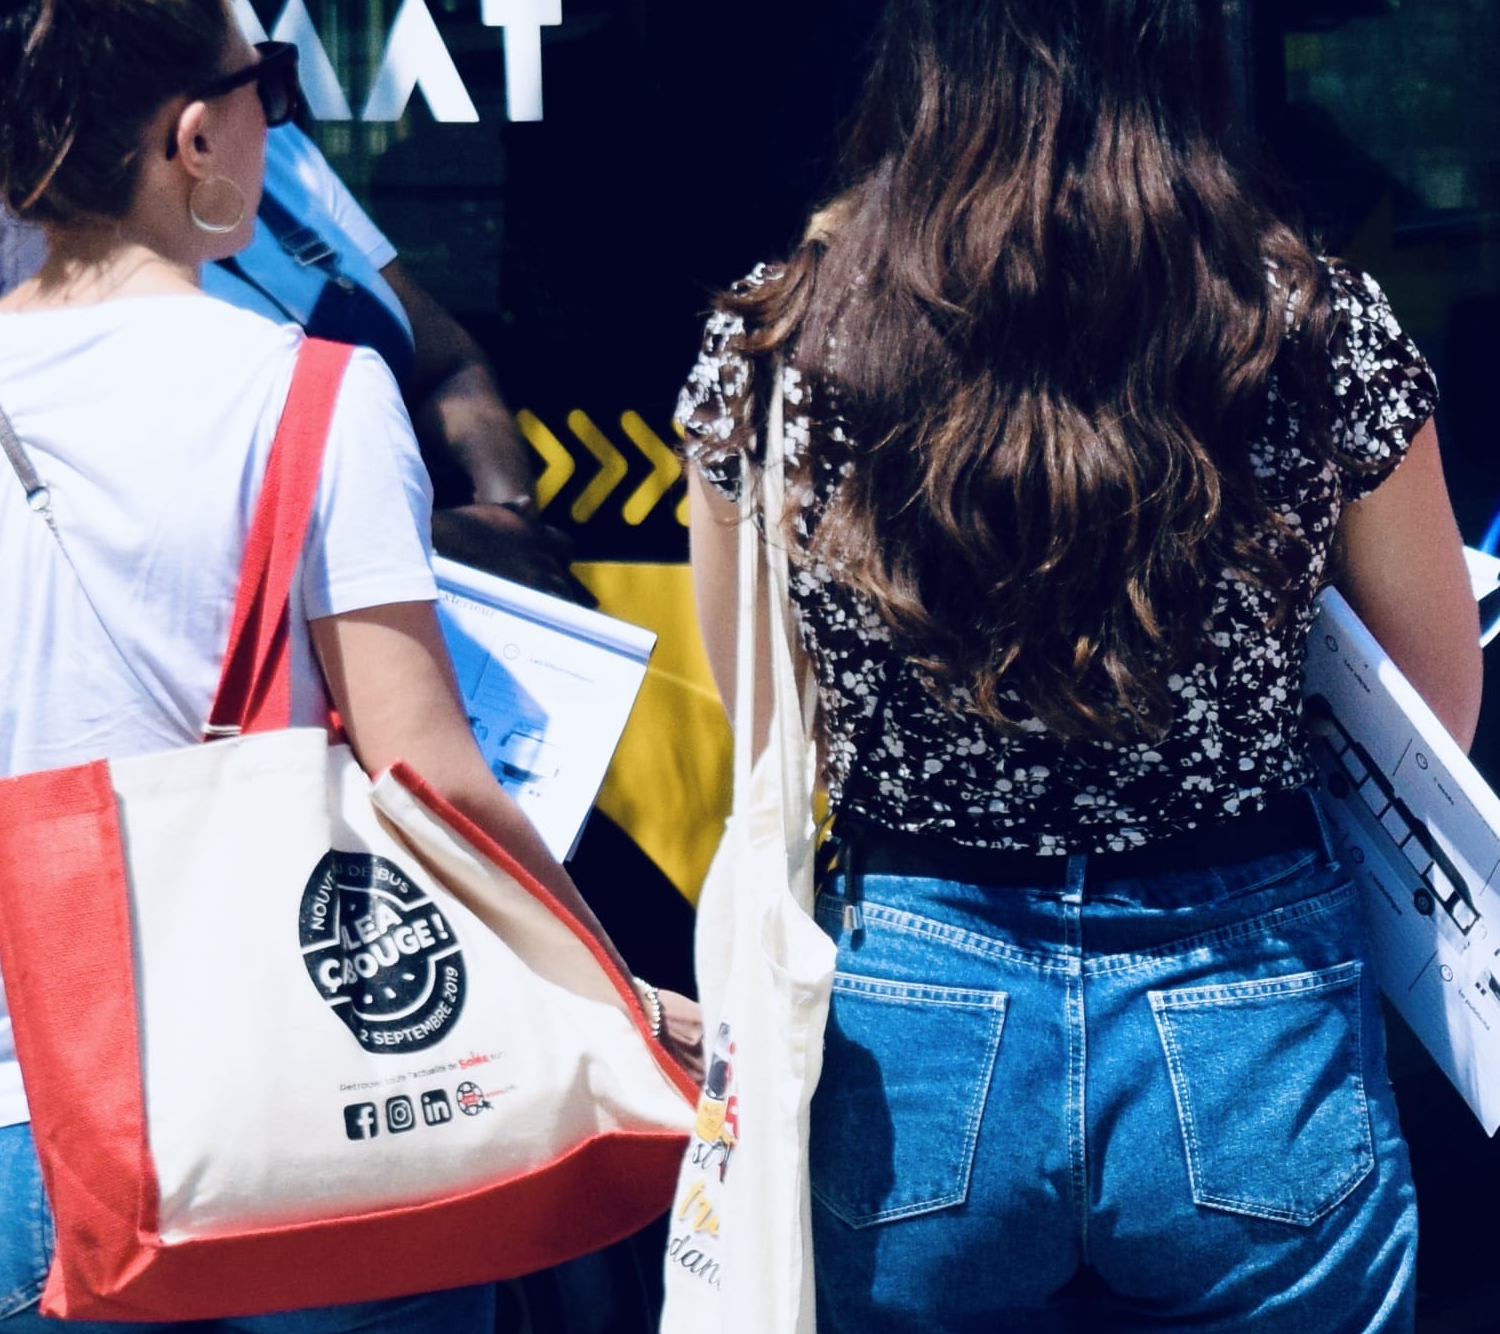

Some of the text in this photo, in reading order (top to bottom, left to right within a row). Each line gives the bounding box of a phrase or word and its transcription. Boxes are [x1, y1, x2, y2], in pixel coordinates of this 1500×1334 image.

[376, 865, 411, 895] BUS
[373, 1002, 454, 1047] SEPTEMBRE
[443, 965, 460, 1004] 2019
